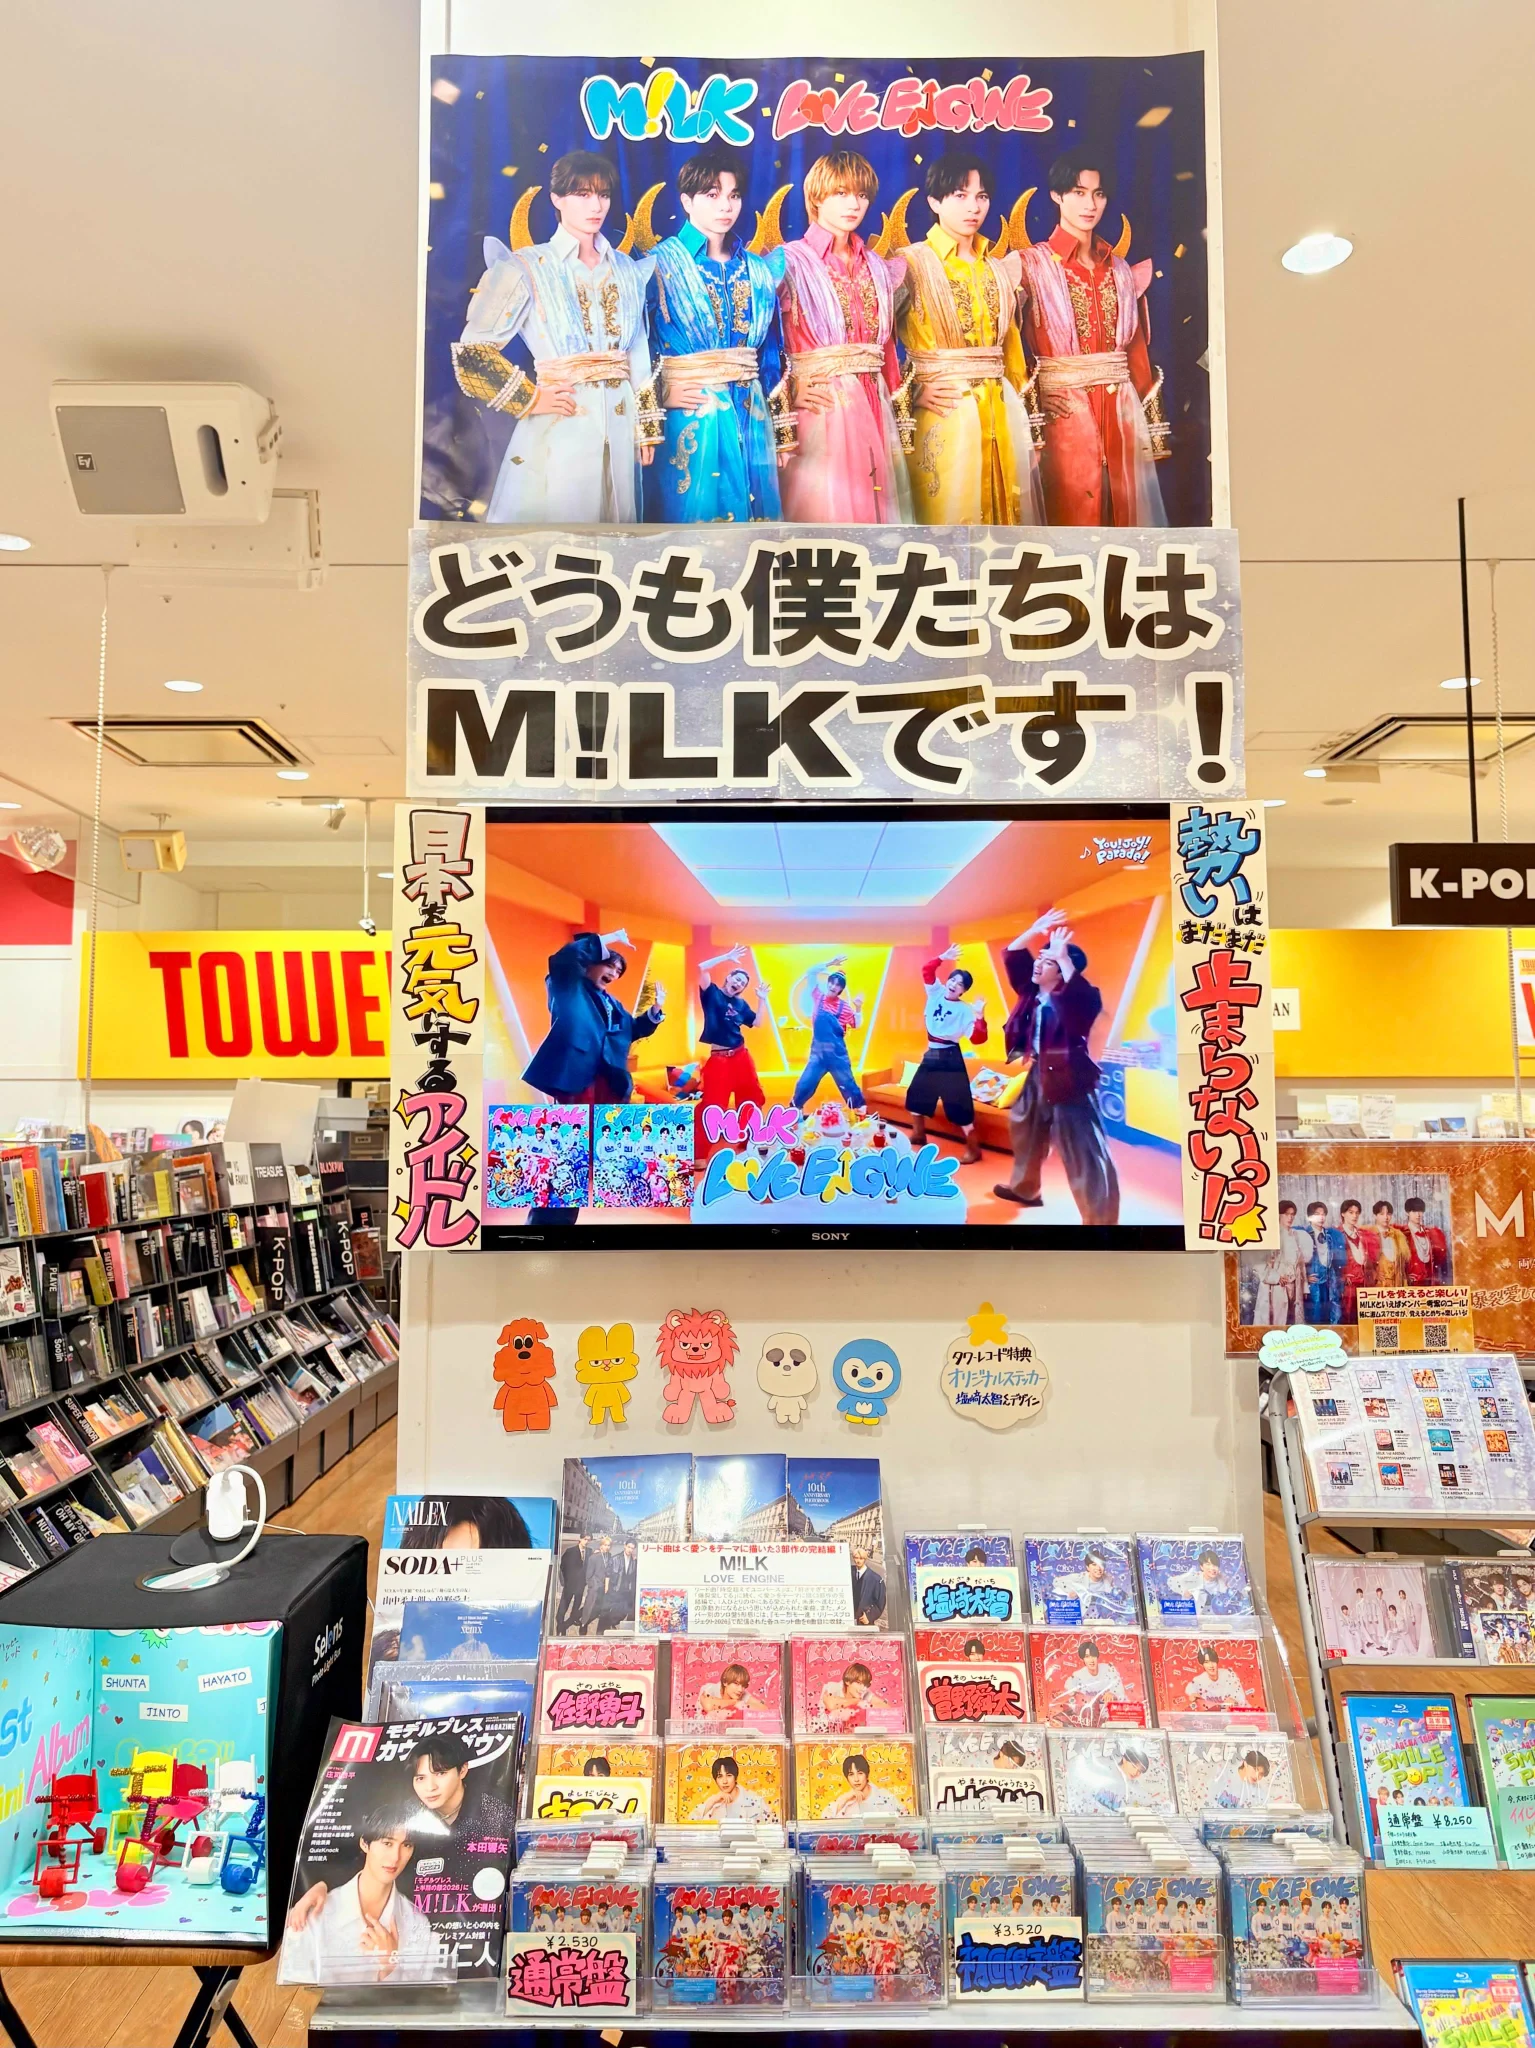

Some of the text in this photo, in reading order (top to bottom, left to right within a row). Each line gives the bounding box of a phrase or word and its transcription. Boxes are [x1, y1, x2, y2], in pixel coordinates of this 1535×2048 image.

[579, 66, 760, 146] M!LK
[772, 79, 881, 142] LOVE
[423, 547, 1218, 657] どうも僕たちは
[1096, 848, 1151, 865] Parade!
[1409, 867, 1535, 899] K-PO
[1179, 920, 1267, 956] まだまだ
[149, 951, 391, 1058] TOWE
[397, 809, 480, 1249] 日本を元気にするアイドル
[255, 1165, 284, 1178] TREASURE
[701, 1147, 799, 1207] LOVE
[1475, 1189, 1535, 1238] M
[337, 1220, 355, 1276] K-POP
[811, 1232, 850, 1242] SONY
[49, 1267, 58, 1292] PLAVE
[271, 1236, 286, 1301] K-POP
[54, 1338, 63, 1363] Soojin
[952, 1347, 1032, 1365] タワーレコード特典
[948, 1368, 1046, 1388] オリジナルステッカー
[65, 1397, 99, 1442] SUPER JUNIOR
[807, 1482, 826, 1492] 10th
[55, 1507, 66, 1521] OH
[63, 1519, 76, 1534] MY
[63, 1504, 90, 1536] One Pact
[391, 1501, 450, 1527] NAILEX
[719, 1556, 769, 1571] M!LK
[703, 1574, 735, 1583] LOVE
[106, 1677, 147, 1689] SHUNTA
[203, 1671, 247, 1687] HAYATO
[576, 1682, 593, 1690] さの
[971, 1674, 998, 1682] しゅんた
[146, 1707, 181, 1719] JINTO
[547, 1688, 645, 1731] 佐野勇斗
[386, 1717, 483, 1738] モデルプレス
[26, 1714, 91, 1806] Album
[1376, 1743, 1447, 1774] SMILE
[1387, 1811, 1424, 1830] 通常盤
[508, 1946, 631, 2008] 通常盤
[1440, 2018, 1521, 2048] SMILE
